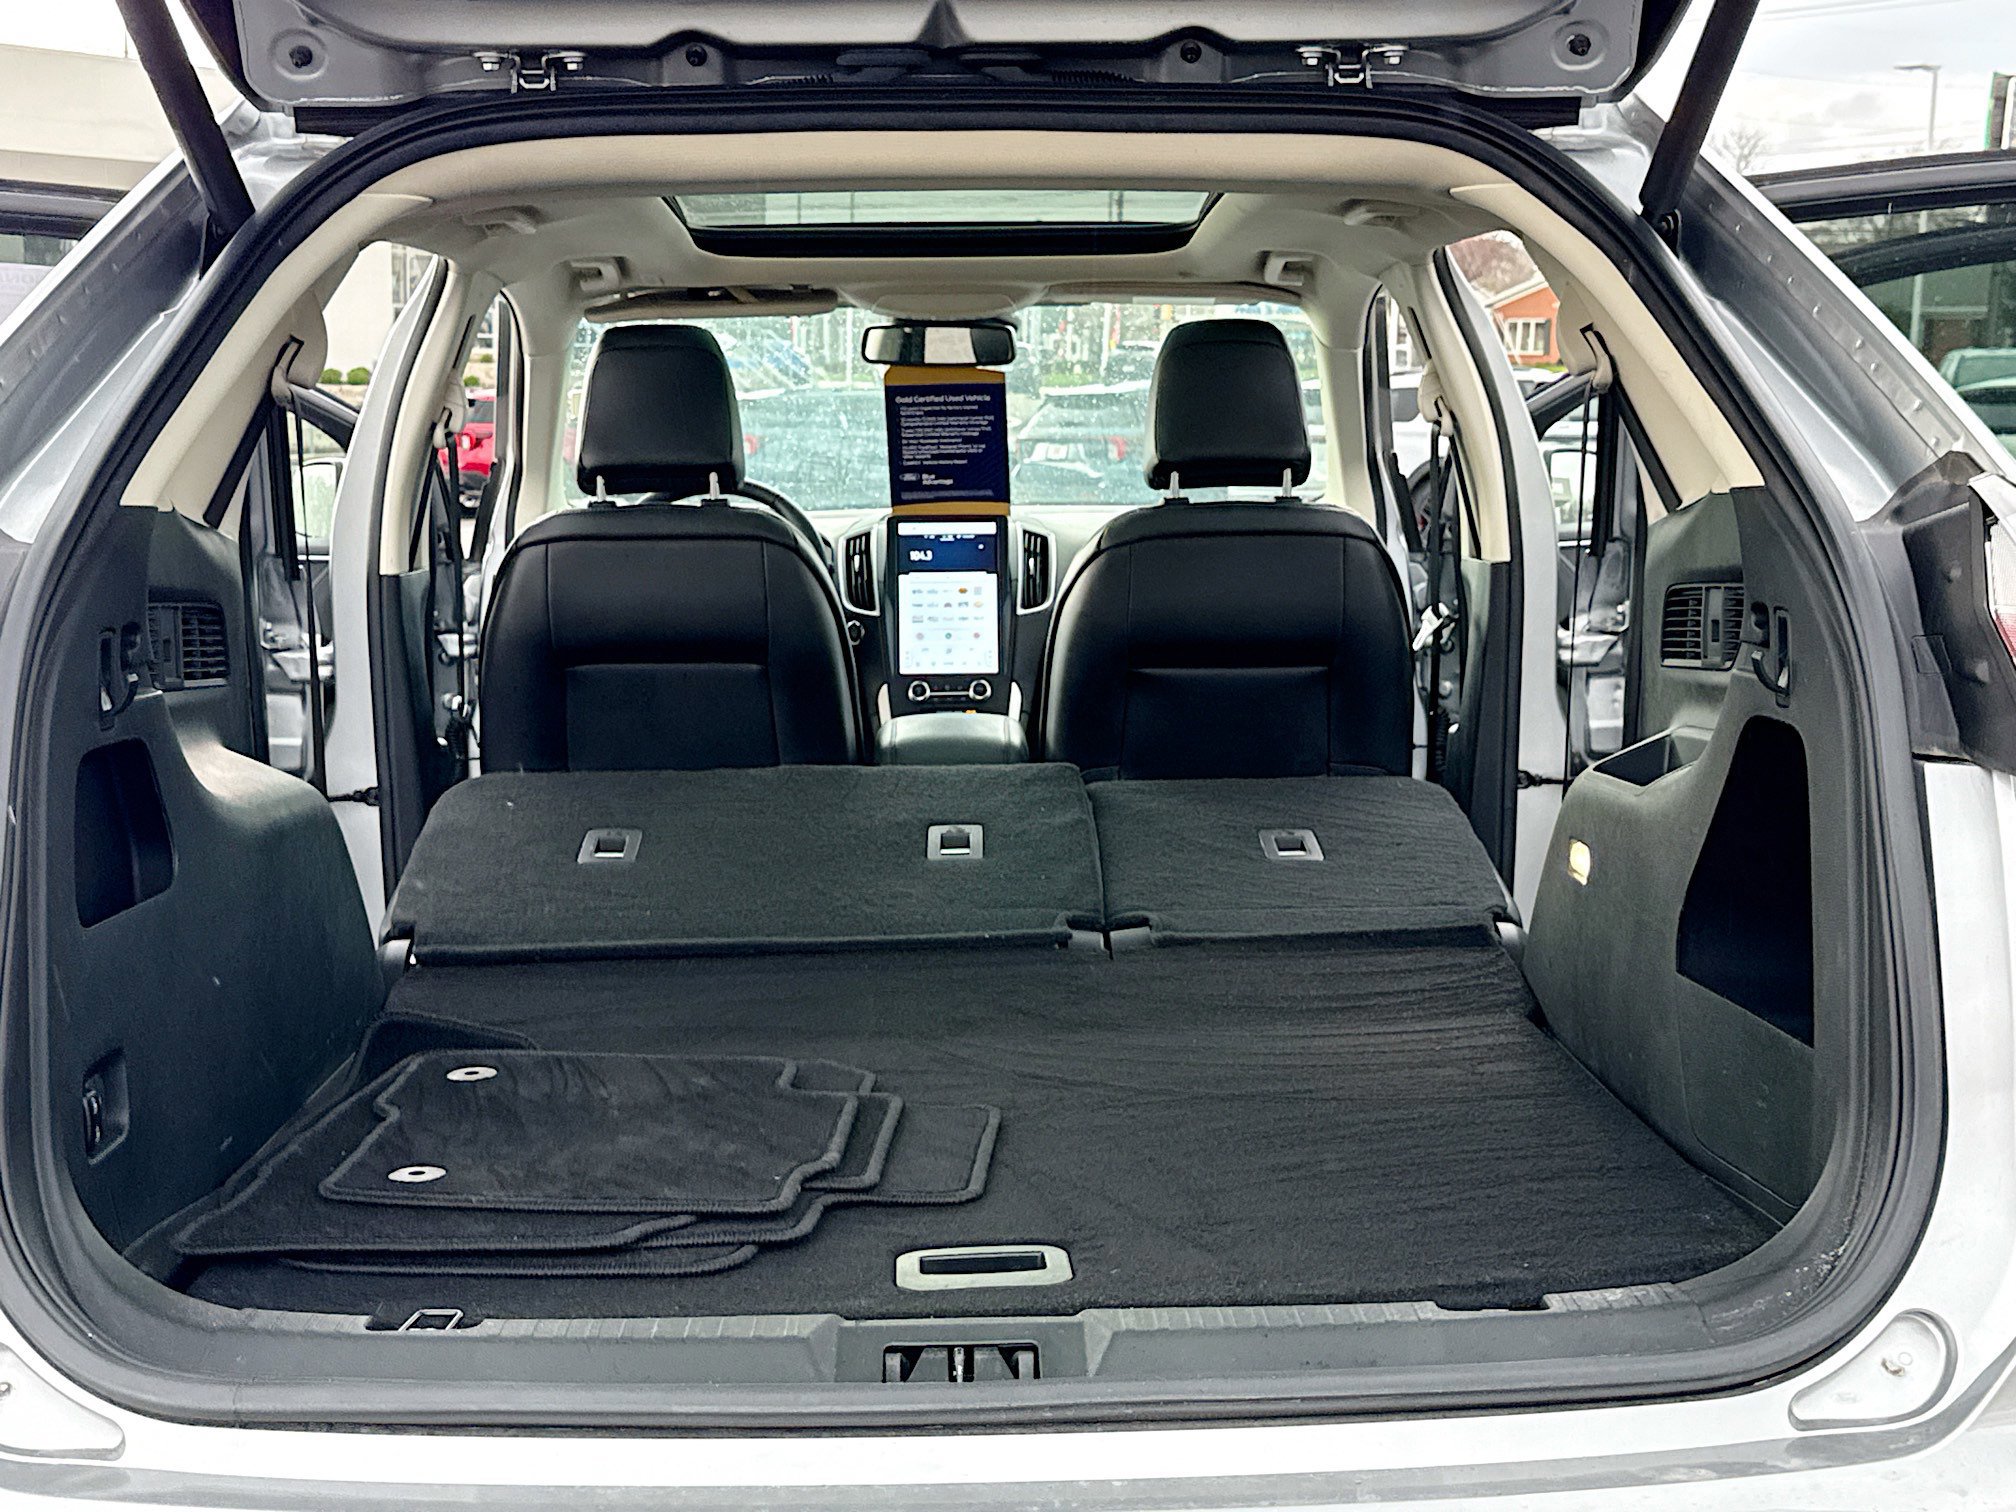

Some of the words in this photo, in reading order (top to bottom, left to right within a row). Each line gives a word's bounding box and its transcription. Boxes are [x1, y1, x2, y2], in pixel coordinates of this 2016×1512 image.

[913, 395, 944, 403] Certified
[944, 394, 964, 402] Used
[964, 394, 991, 402] Vehicle
